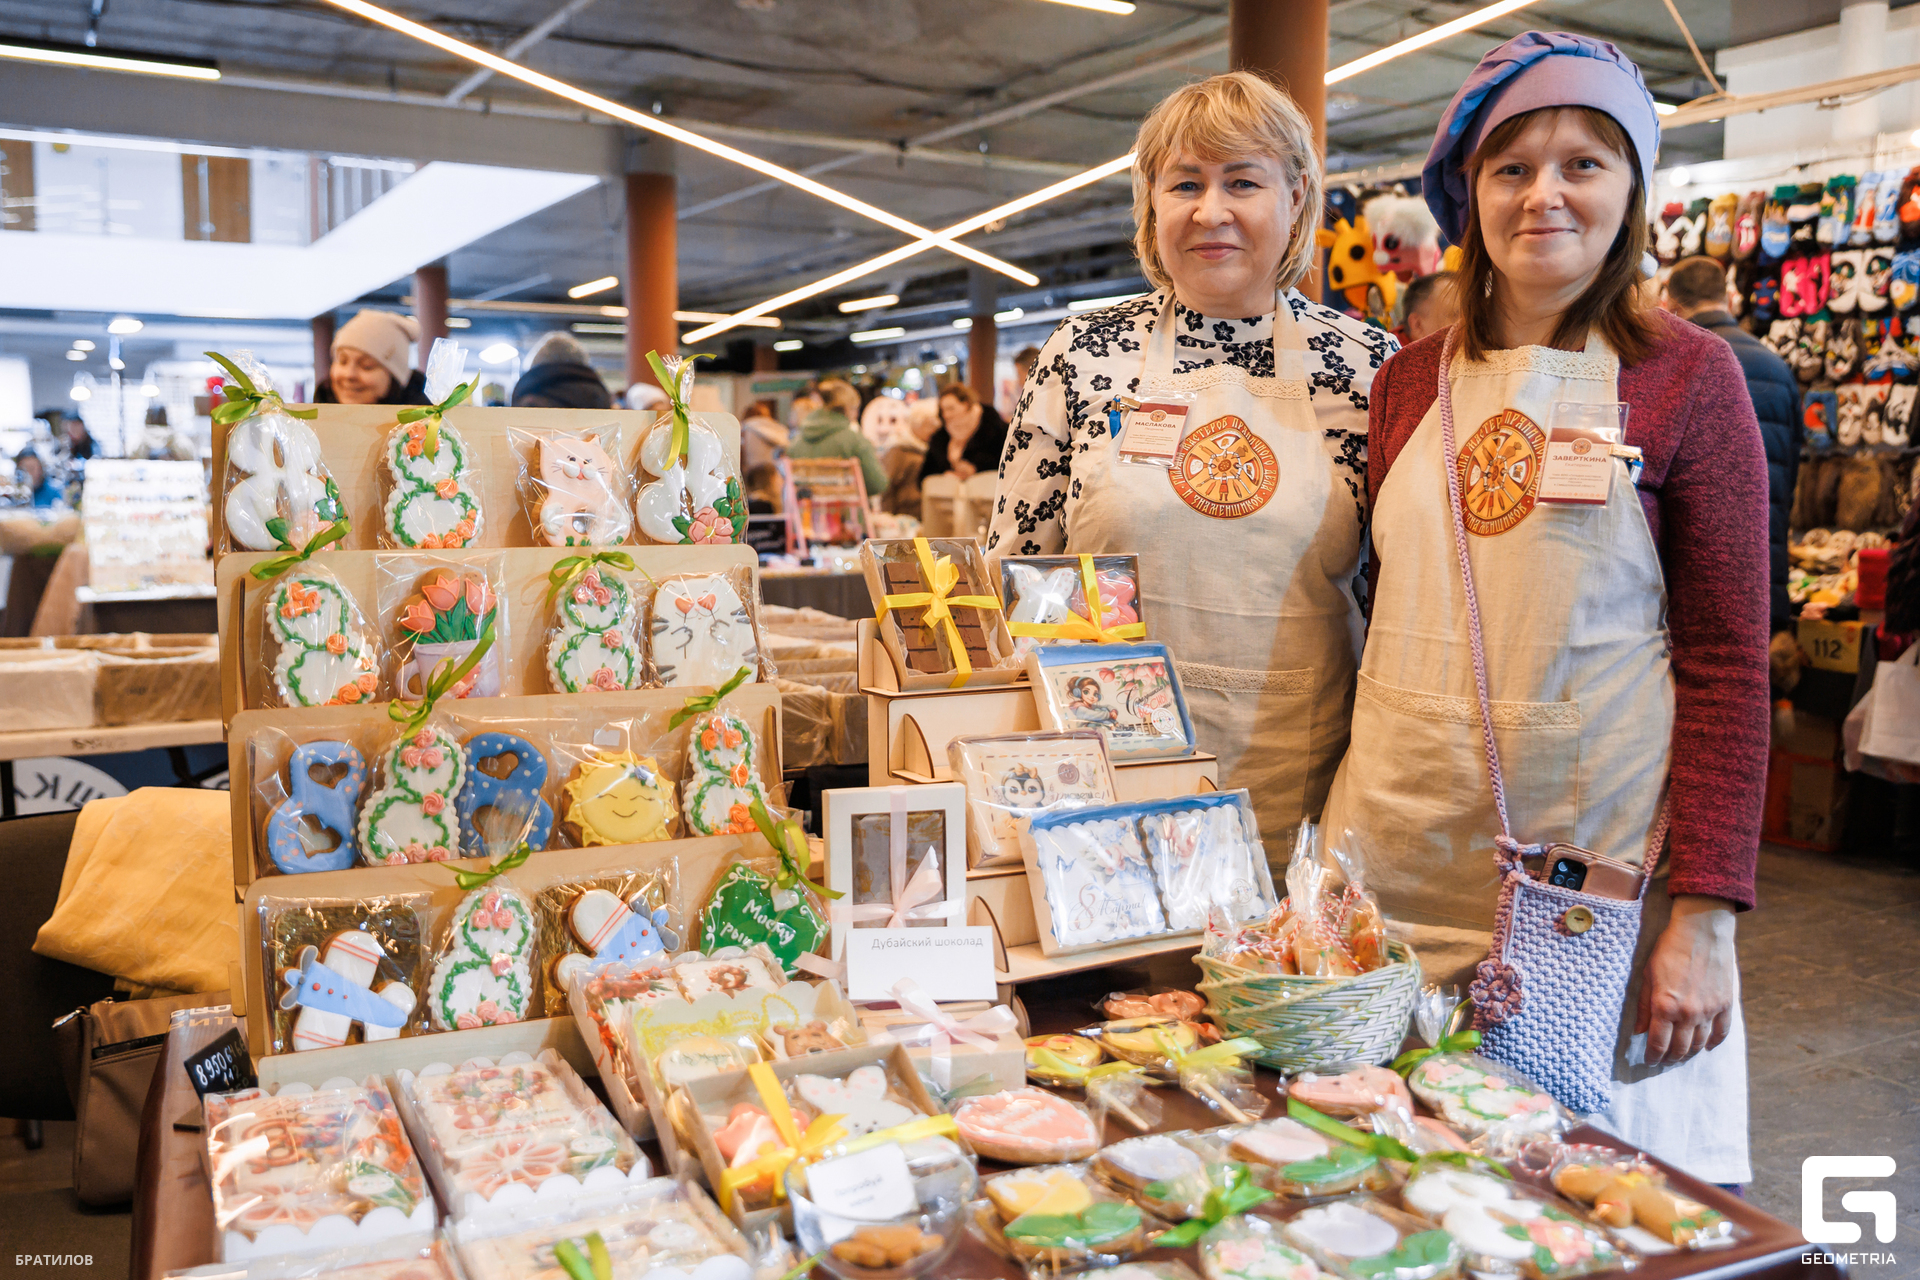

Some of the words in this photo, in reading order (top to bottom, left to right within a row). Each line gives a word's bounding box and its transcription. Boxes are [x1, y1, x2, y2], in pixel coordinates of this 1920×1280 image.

[1465, 416, 1502, 452] МАСТЕР
[1183, 417, 1228, 451] МАСТЕРОВ
[1232, 417, 1275, 466] ПРЯНИЧНОГО
[1261, 468, 1277, 492] ДЕЛА
[1552, 455, 1607, 463] ЗАВЕРТКИНА
[1191, 494, 1264, 517] ЗНАМЕНЩИКОВ
[1465, 502, 1527, 535] ЗНАМЕНЩИКОВ
[1814, 638, 1842, 660] 112
[871, 937, 932, 950] Дубайский
[934, 937, 984, 947] шоколад
